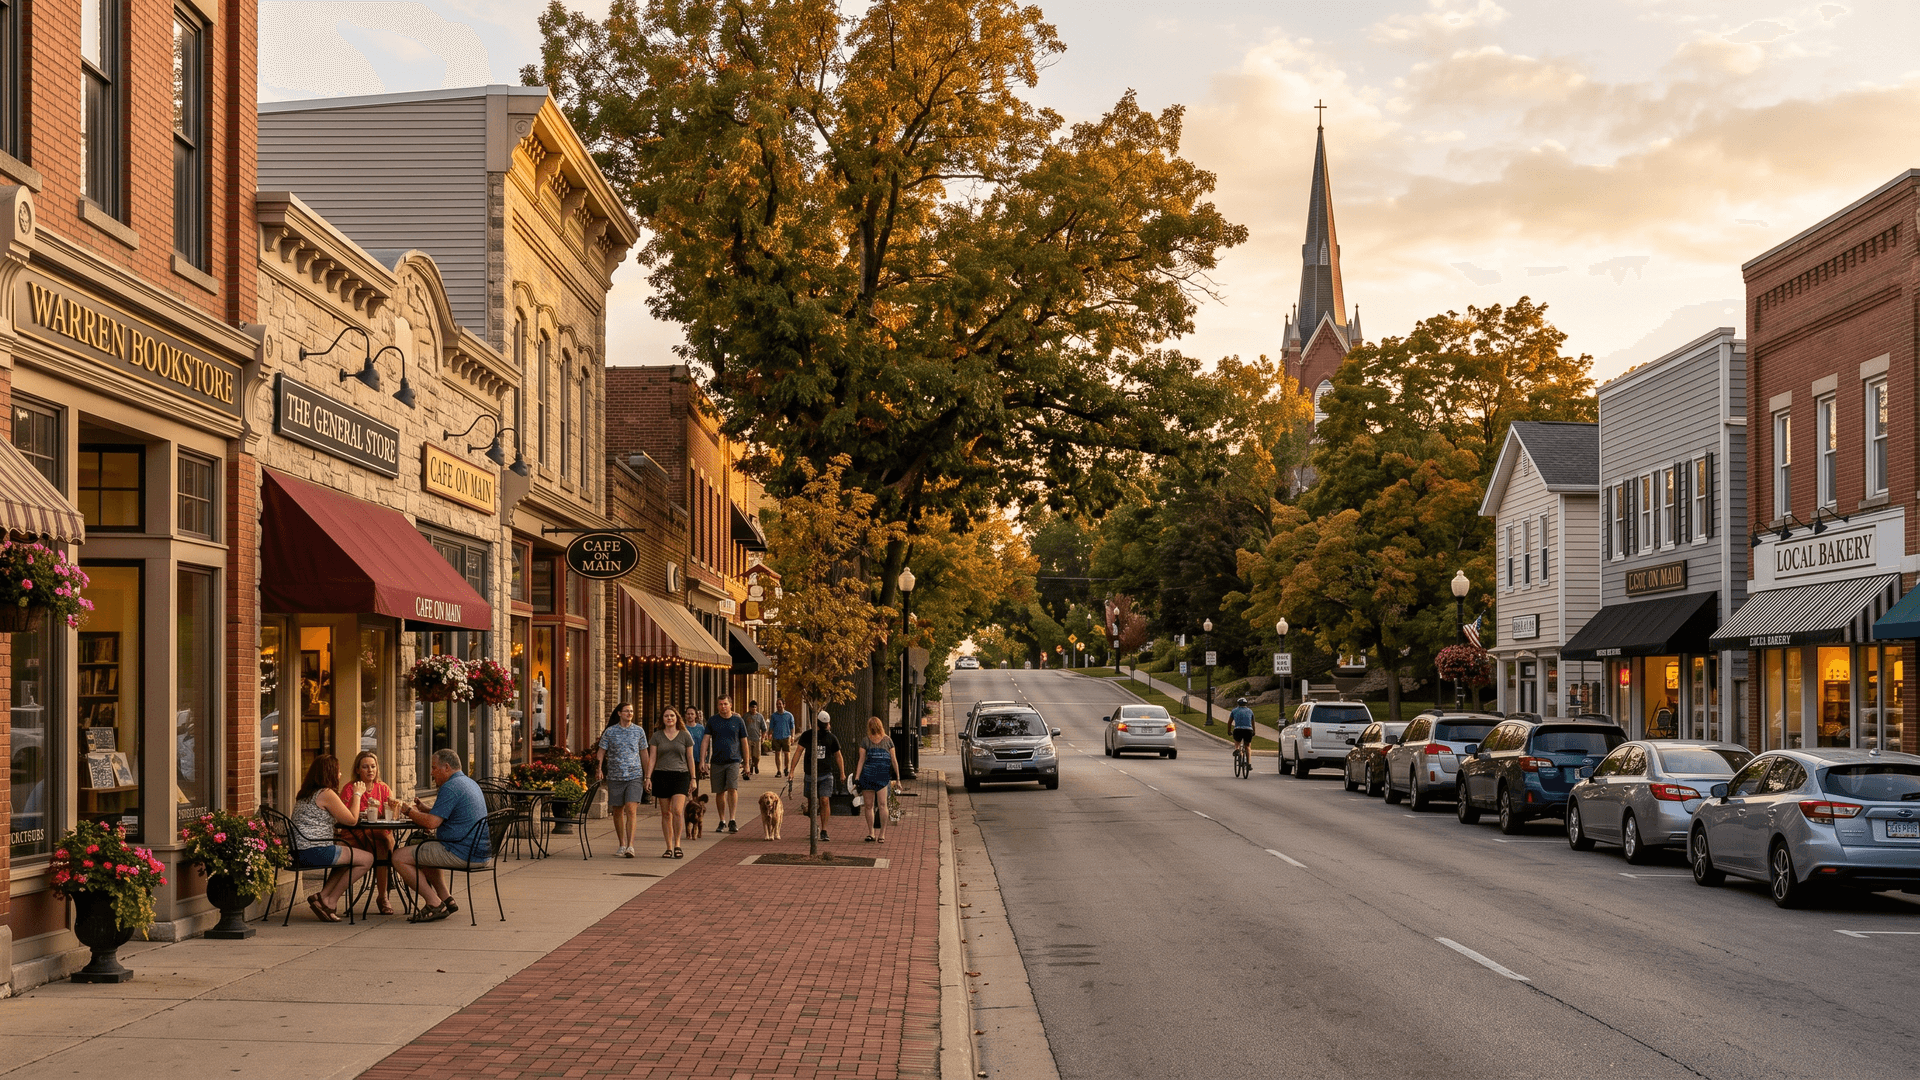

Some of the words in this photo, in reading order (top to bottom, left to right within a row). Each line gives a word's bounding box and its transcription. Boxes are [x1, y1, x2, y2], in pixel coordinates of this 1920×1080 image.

[28, 281, 126, 360] WARREN
[130, 328, 234, 404] BOOKSTORE
[286, 392, 311, 428] THE
[314, 405, 364, 450] GENERAL
[366, 428, 396, 464] STORE
[430, 456, 452, 488] CAFE
[456, 467, 468, 494] ON
[470, 473, 492, 504] MAIN
[583, 540, 620, 552] CAFE
[1776, 545, 1816, 572] LOCAL
[1819, 534, 1872, 566] BAKERY
[582, 560, 621, 571] MAIN
[416, 596, 433, 619] CAFE
[434, 600, 444, 620] ON
[445, 602, 461, 622] MAIN
